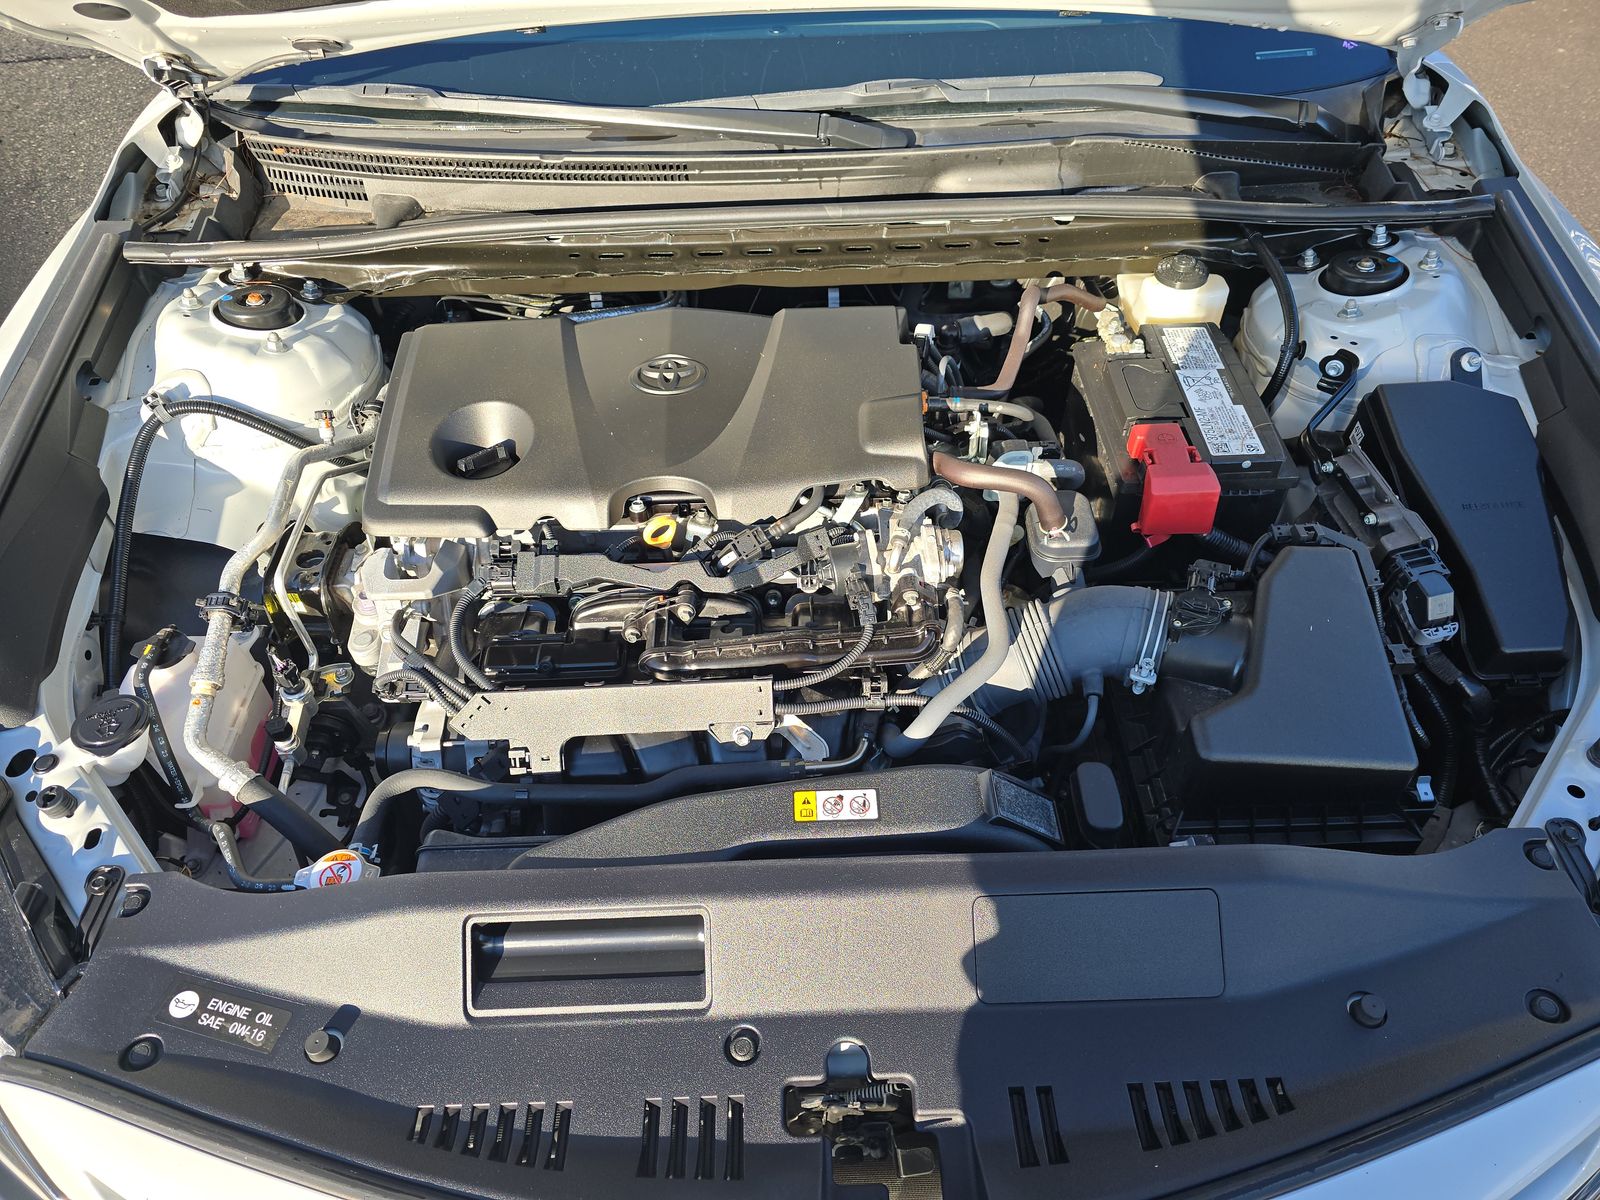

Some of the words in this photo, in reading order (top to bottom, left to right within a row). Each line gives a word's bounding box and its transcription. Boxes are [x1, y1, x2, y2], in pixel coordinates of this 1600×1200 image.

[197, 1012, 225, 1030] SAE
[228, 1021, 267, 1042] 0W-16
[206, 997, 252, 1020] ENGINE
[254, 1011, 273, 1027] OIL
